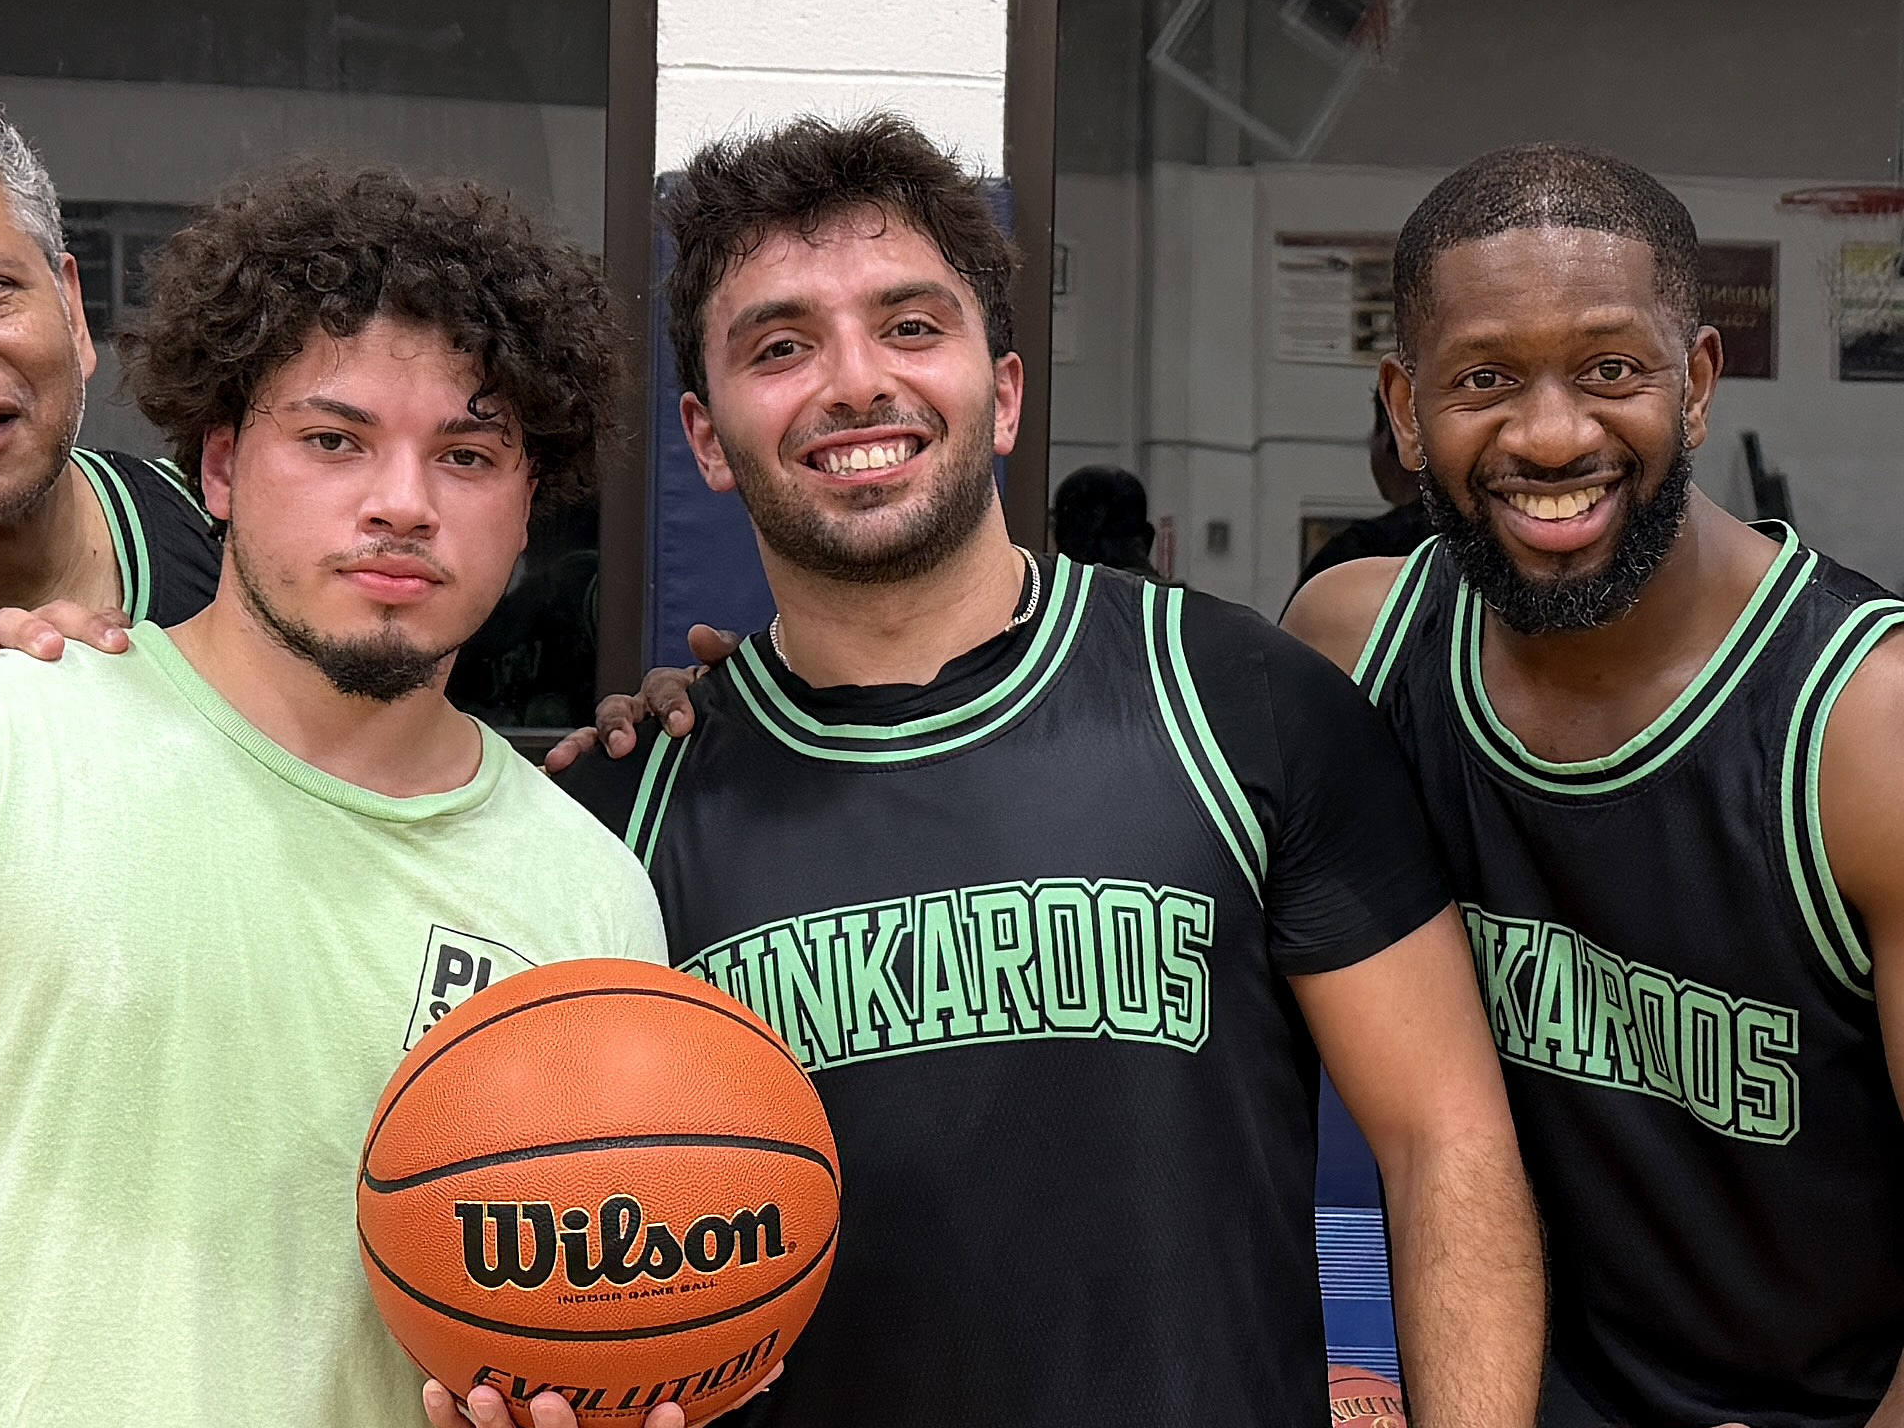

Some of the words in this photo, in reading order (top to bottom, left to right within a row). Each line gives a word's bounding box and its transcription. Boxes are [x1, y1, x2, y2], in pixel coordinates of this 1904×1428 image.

[1459, 902, 1801, 1145] KAROOS
[453, 1193, 786, 1290] Wilson
[557, 1292, 623, 1305] INDOOR
[628, 1285, 675, 1300] GAME
[680, 1279, 719, 1294] BALL
